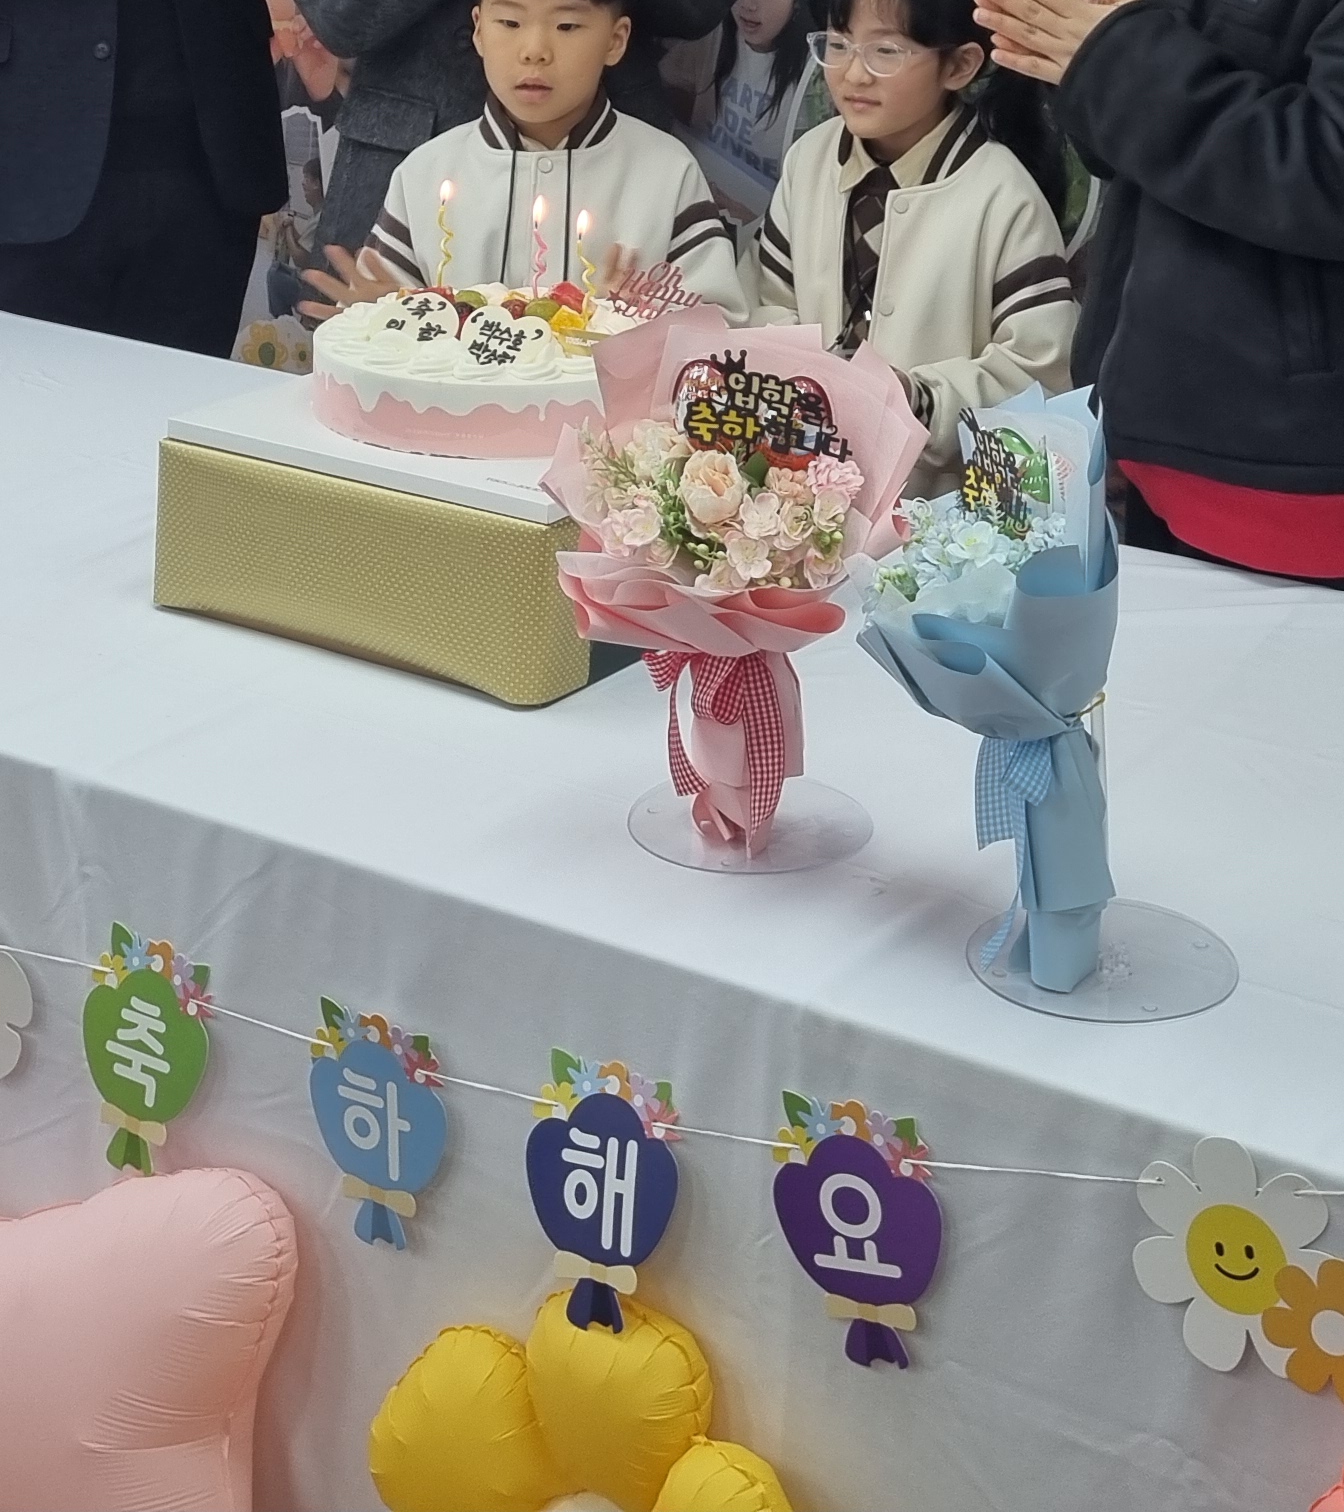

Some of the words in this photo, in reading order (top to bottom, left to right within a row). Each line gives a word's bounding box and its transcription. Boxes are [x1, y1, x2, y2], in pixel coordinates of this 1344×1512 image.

[724, 109, 753, 146] DE
[618, 266, 703, 317] Happy
[647, 261, 684, 289] Oh
